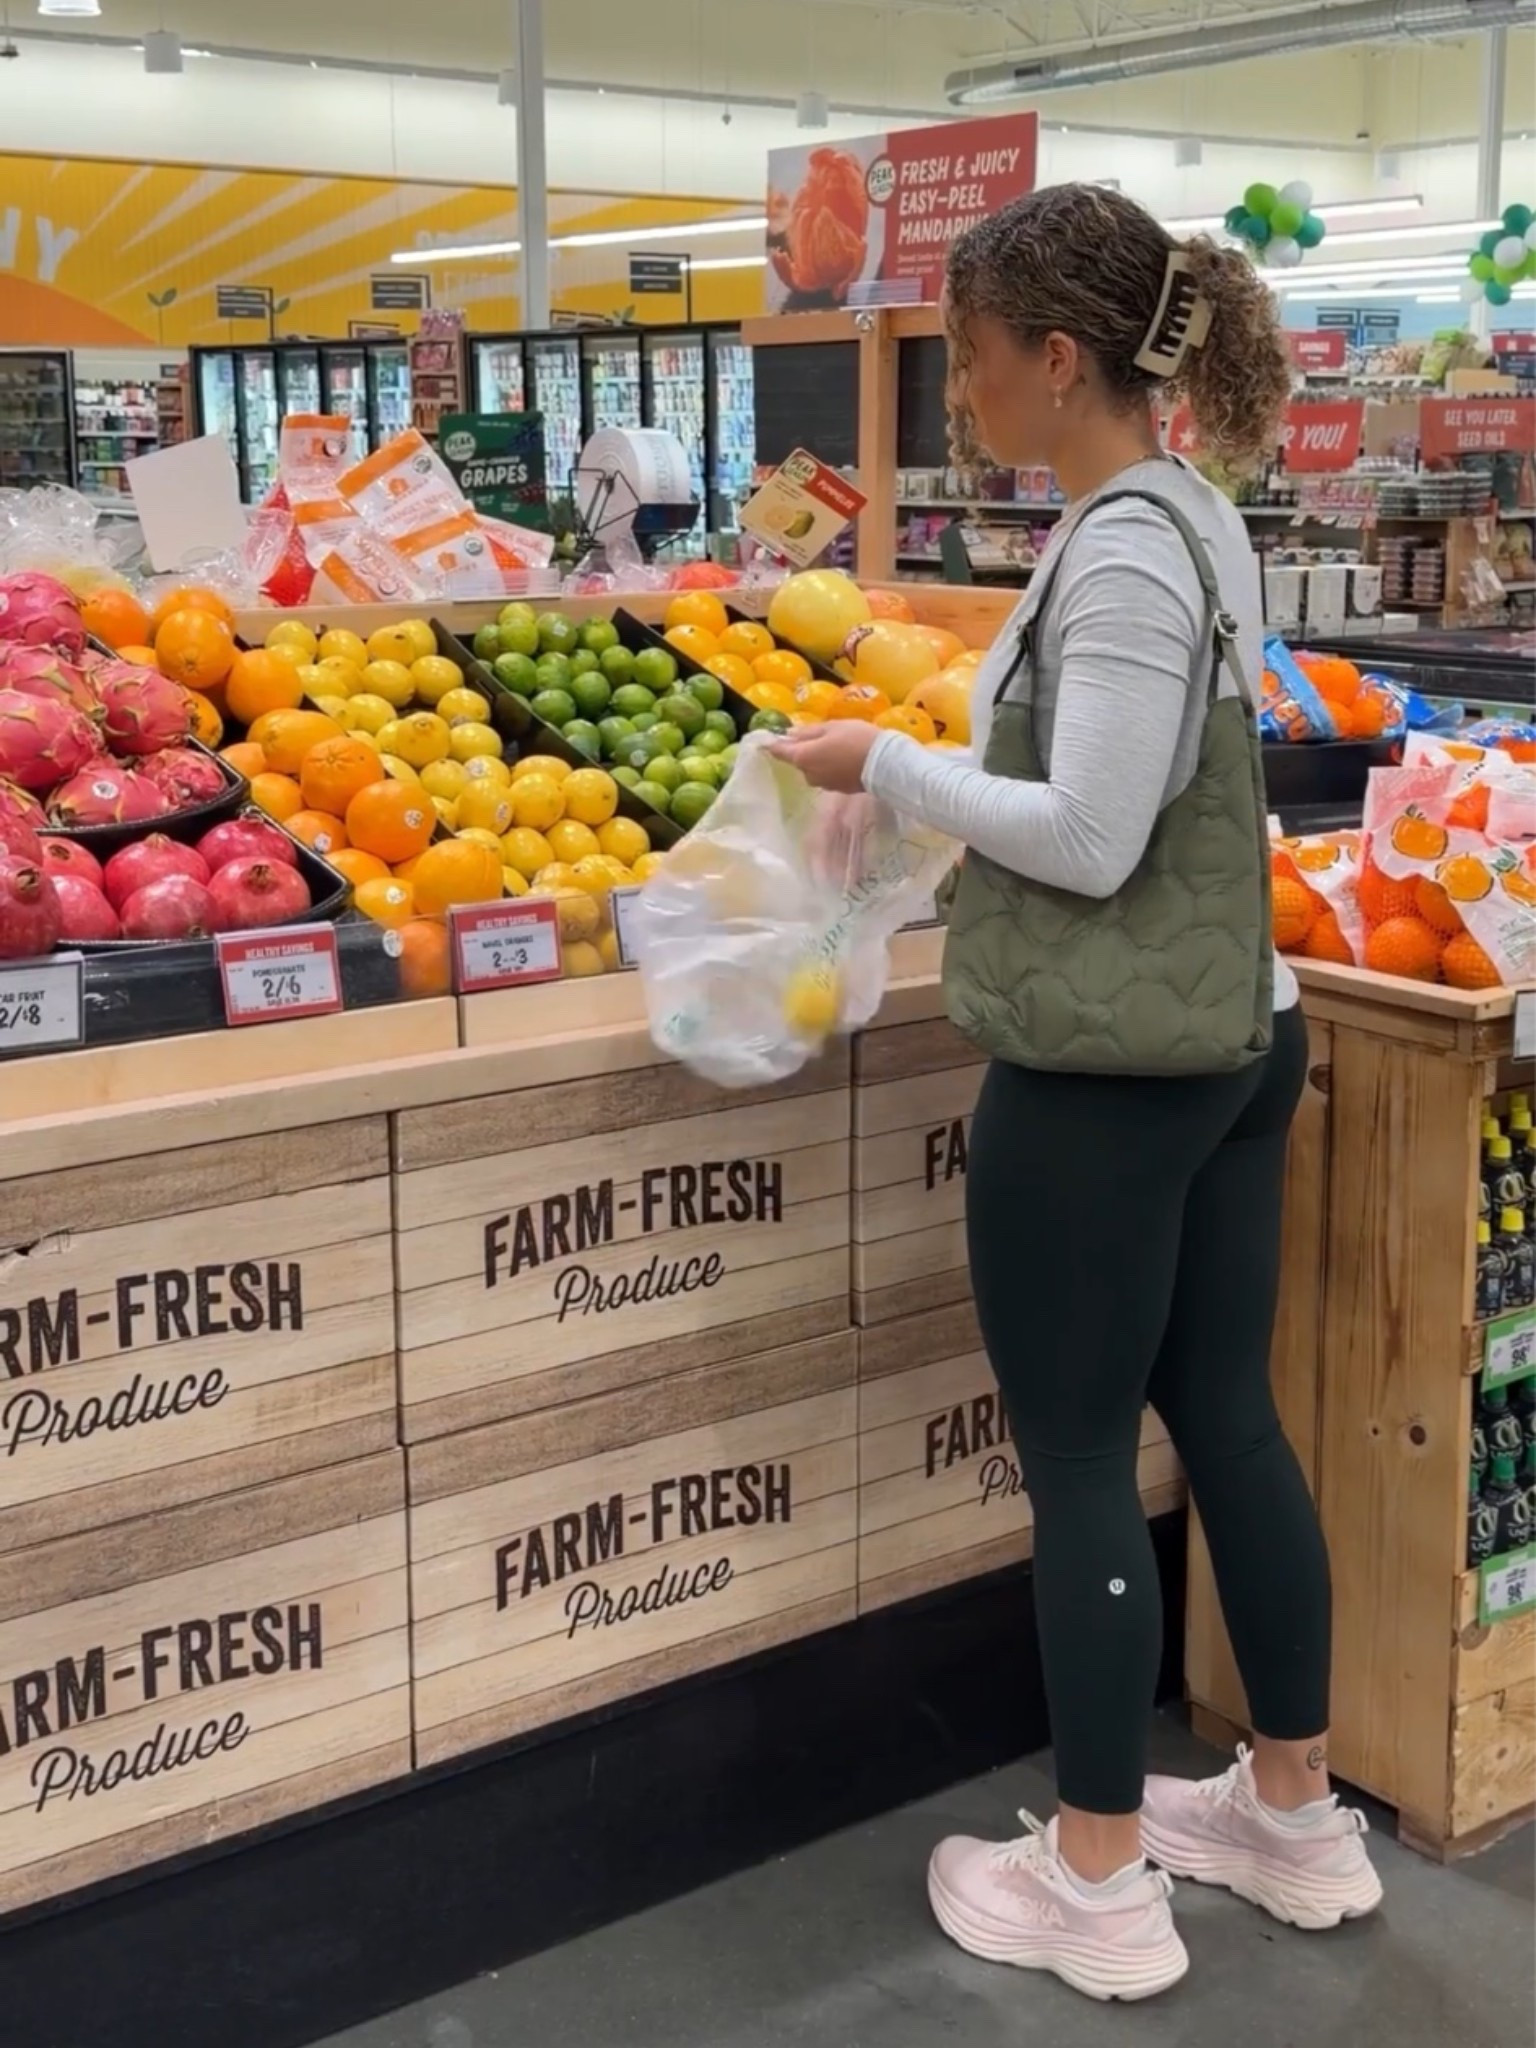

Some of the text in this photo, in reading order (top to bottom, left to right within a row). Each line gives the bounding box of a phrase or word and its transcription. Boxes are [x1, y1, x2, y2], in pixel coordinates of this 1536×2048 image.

[899, 148, 1021, 186] FRESH & JUICY
[899, 184, 986, 216] EASY-PEEL
[897, 213, 989, 245] MANDARIN
[1300, 421, 1348, 450] YOU!
[1444, 409, 1462, 427] SEE
[1465, 409, 1485, 425] YOU
[460, 464, 528, 488] GRAPES
[18, 990, 45, 1002] FRUIT
[484, 1160, 782, 1289] FARM-FRESH
[554, 1252, 726, 1323] Produce
[2, 1368, 230, 1456] Produce
[979, 1455, 1027, 1506] Pr
[495, 1464, 790, 1612] FARM-FRESH
[564, 1557, 734, 1639] Produce
[31, 1711, 250, 1813] Produce
